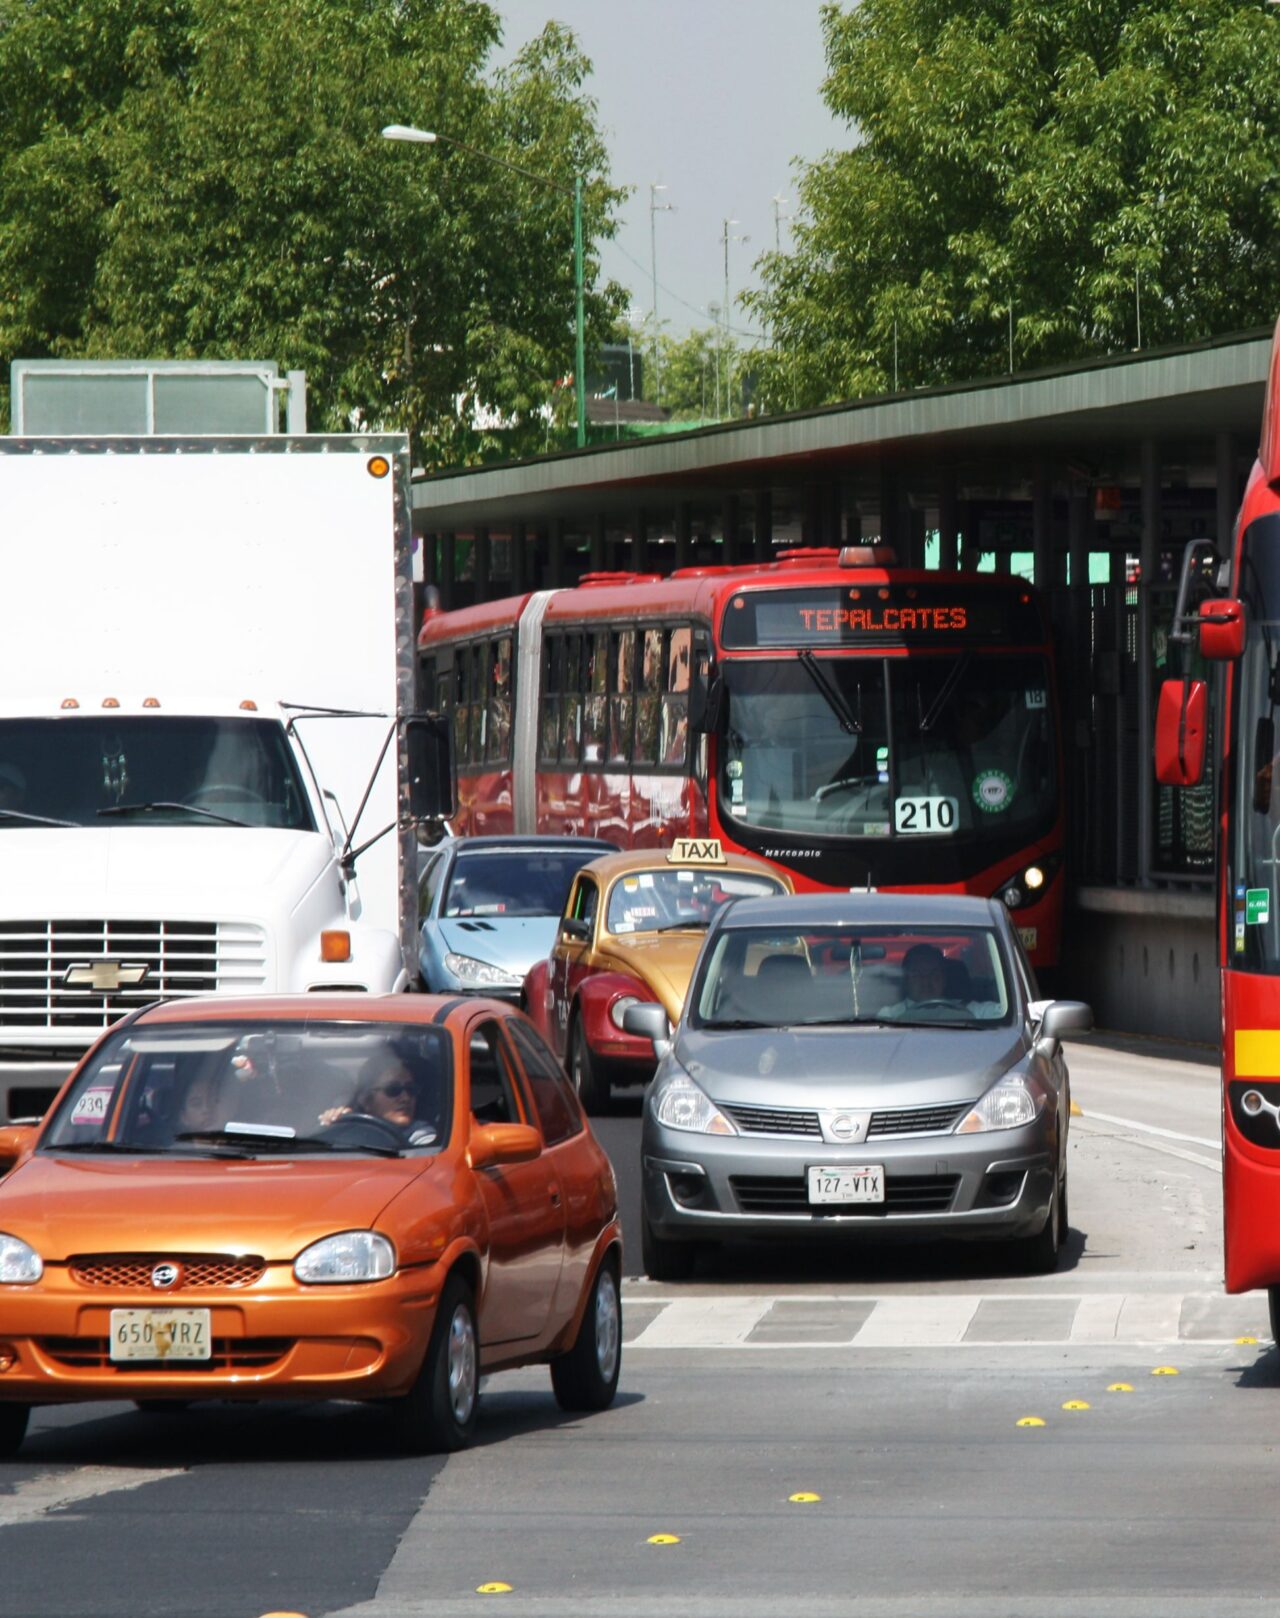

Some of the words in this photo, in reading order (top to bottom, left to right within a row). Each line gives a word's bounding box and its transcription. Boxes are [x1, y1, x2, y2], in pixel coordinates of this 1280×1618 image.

[800, 608, 967, 631] TEPALCATES
[900, 801, 954, 829] 210
[677, 842, 719, 859] TAXI
